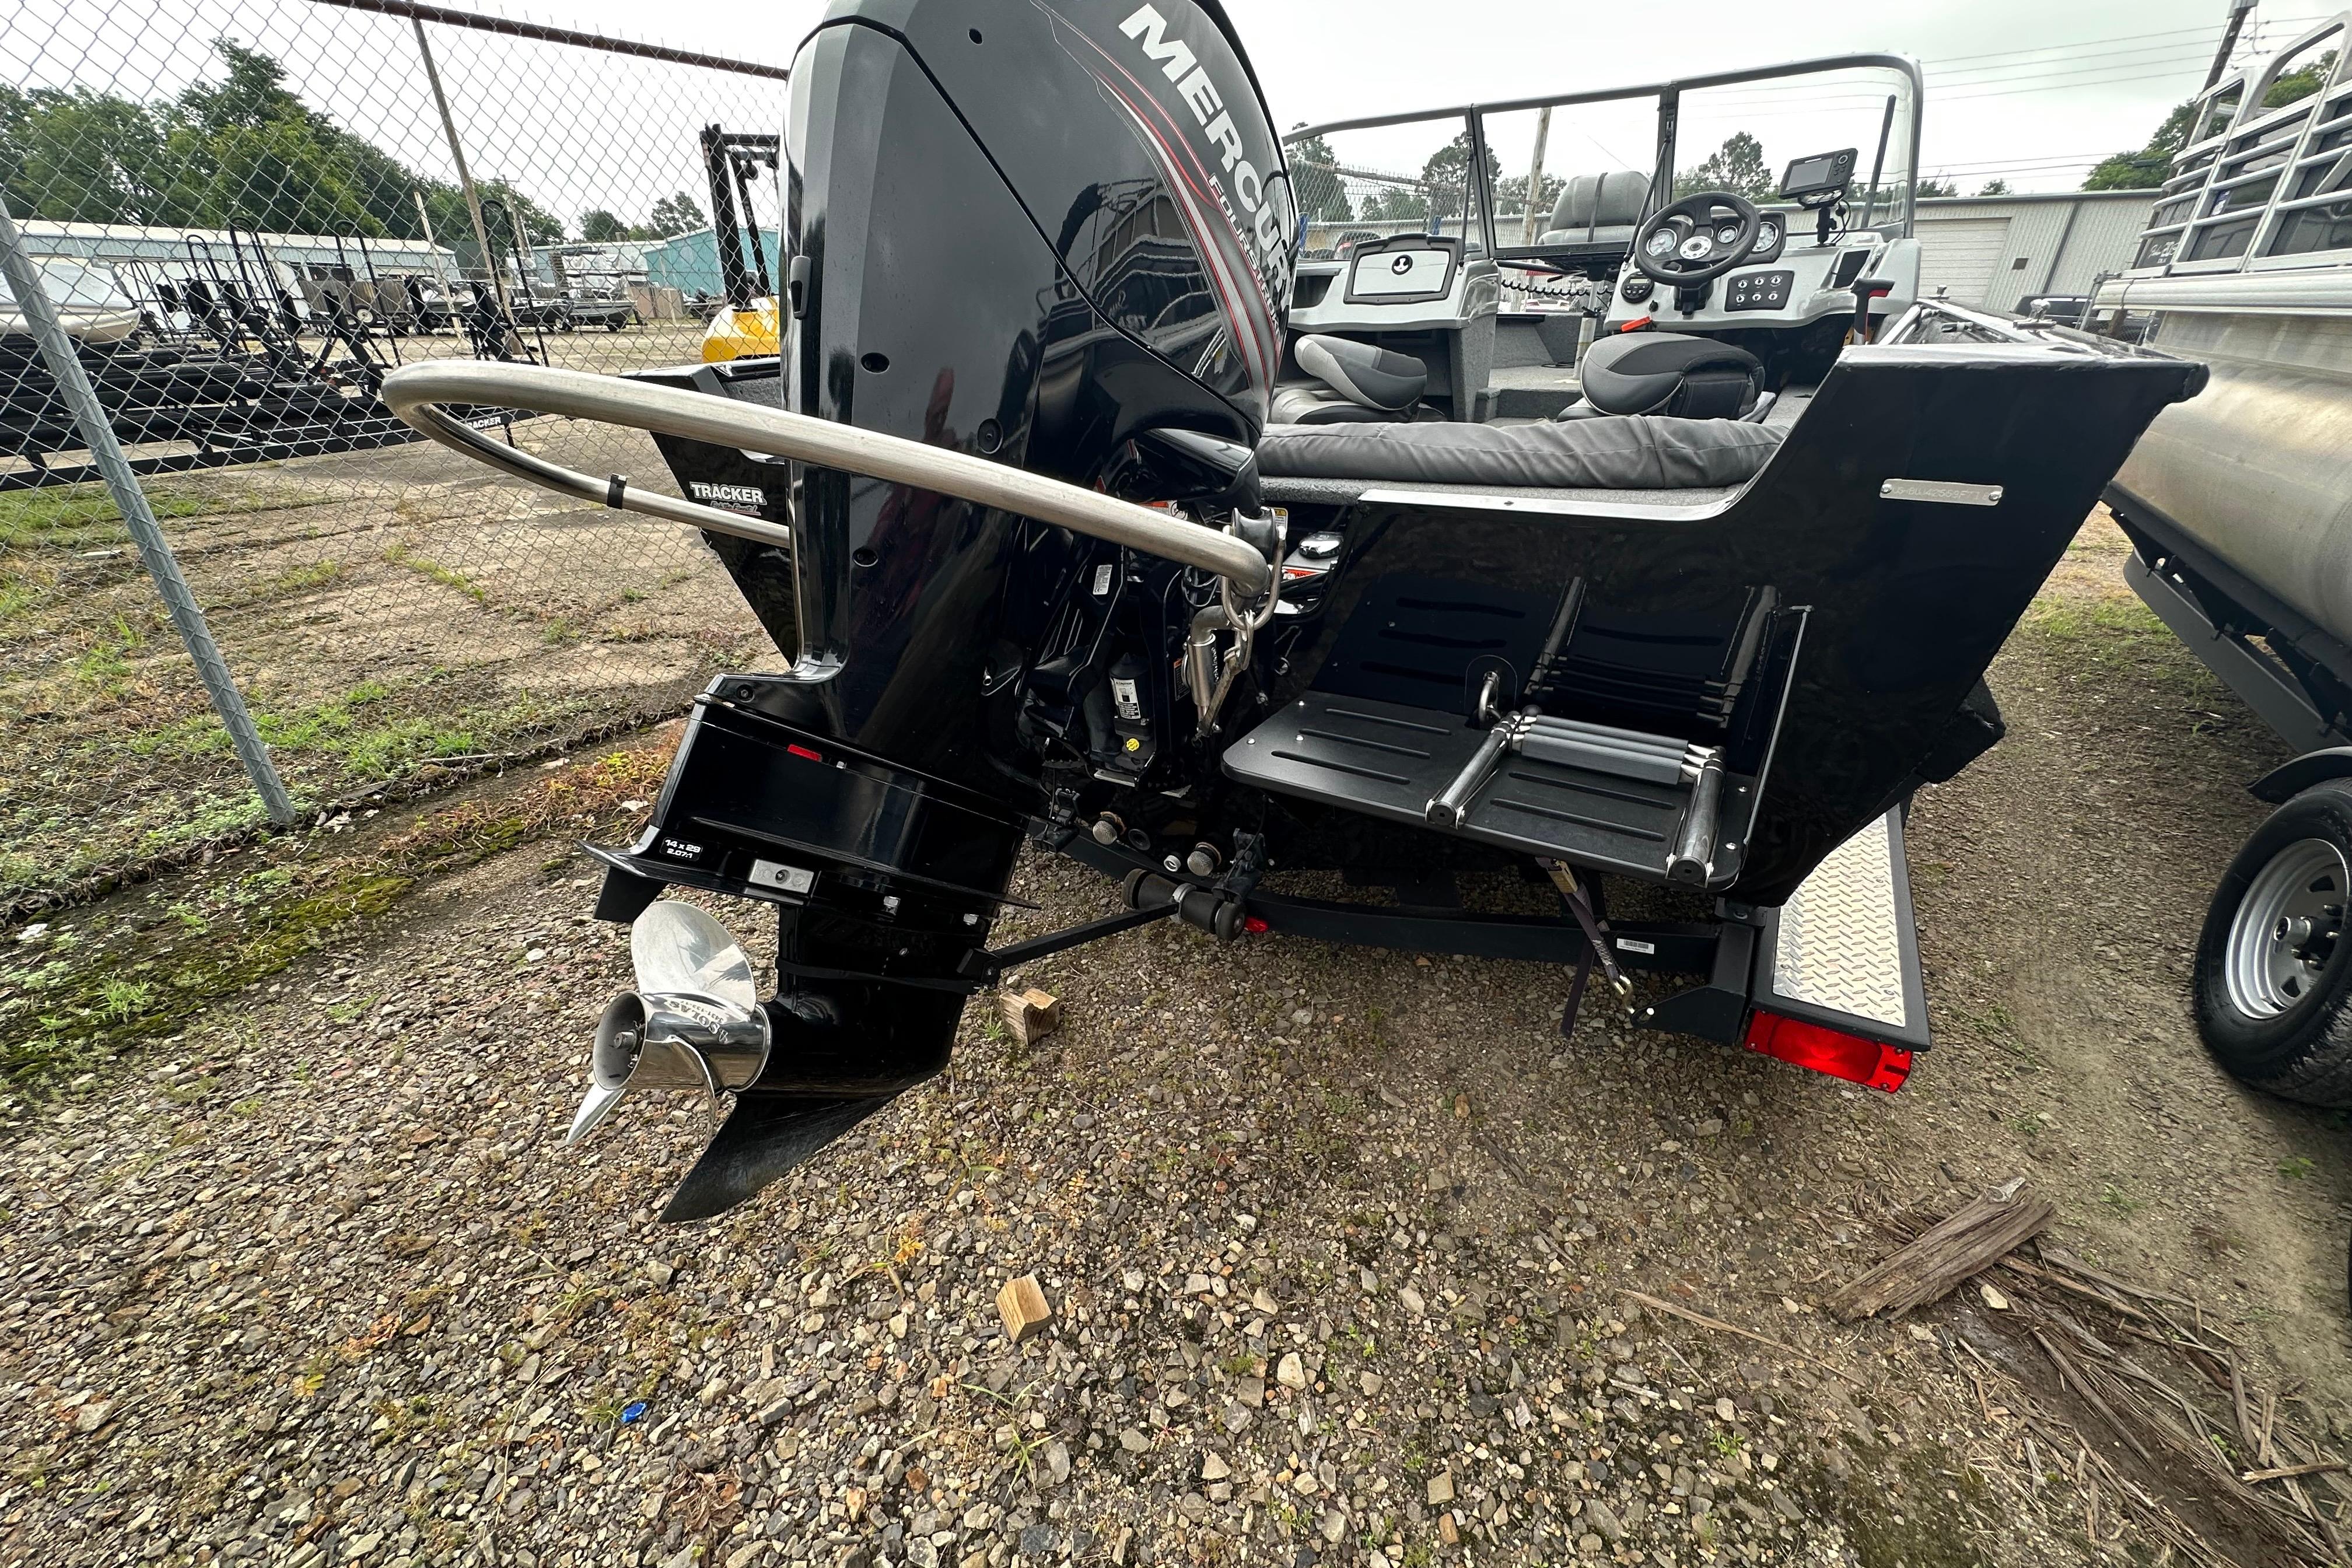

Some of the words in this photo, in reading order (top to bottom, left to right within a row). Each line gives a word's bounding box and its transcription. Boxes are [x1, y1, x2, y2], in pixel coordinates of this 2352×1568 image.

[467, 416, 501, 429] RACKER
[691, 484, 764, 503] TRACKER
[665, 839, 678, 848] 14
[685, 844, 701, 853] 29
[667, 848, 693, 858] 2.07:1
[669, 1000, 720, 1035] SOLAS
